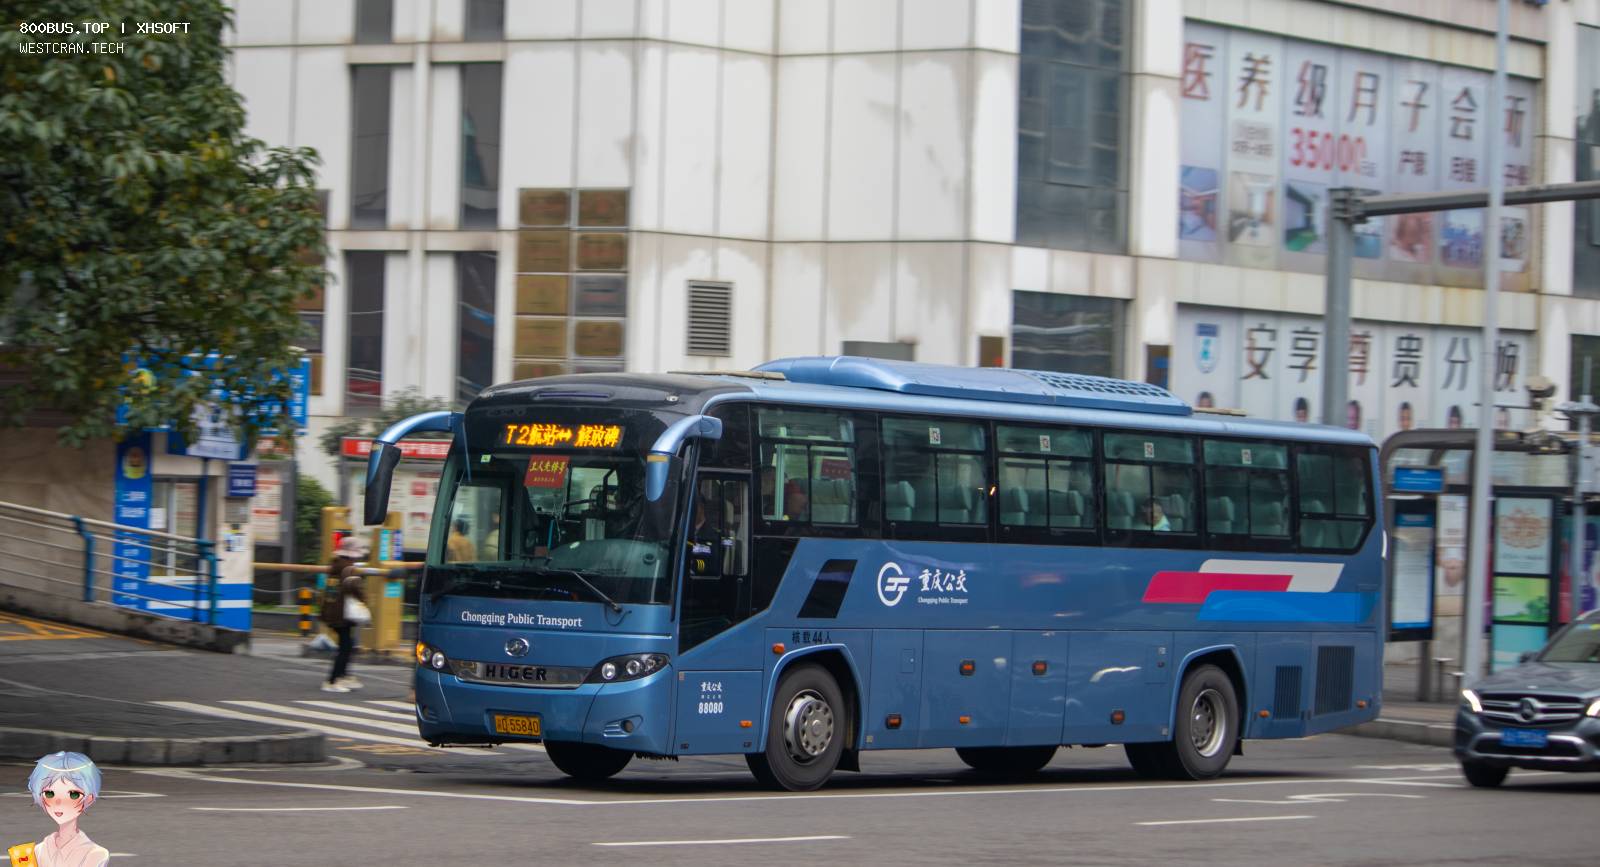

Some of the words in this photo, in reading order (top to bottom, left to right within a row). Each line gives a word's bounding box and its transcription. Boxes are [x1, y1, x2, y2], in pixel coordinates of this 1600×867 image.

[573, 424, 621, 448] 解放碑
[918, 568, 969, 593] 重庆公交
[461, 610, 505, 626] Chongqing
[507, 613, 535, 625] Public
[537, 614, 583, 629] Transport
[485, 664, 548, 681] HIGER
[698, 701, 724, 714] 88080
